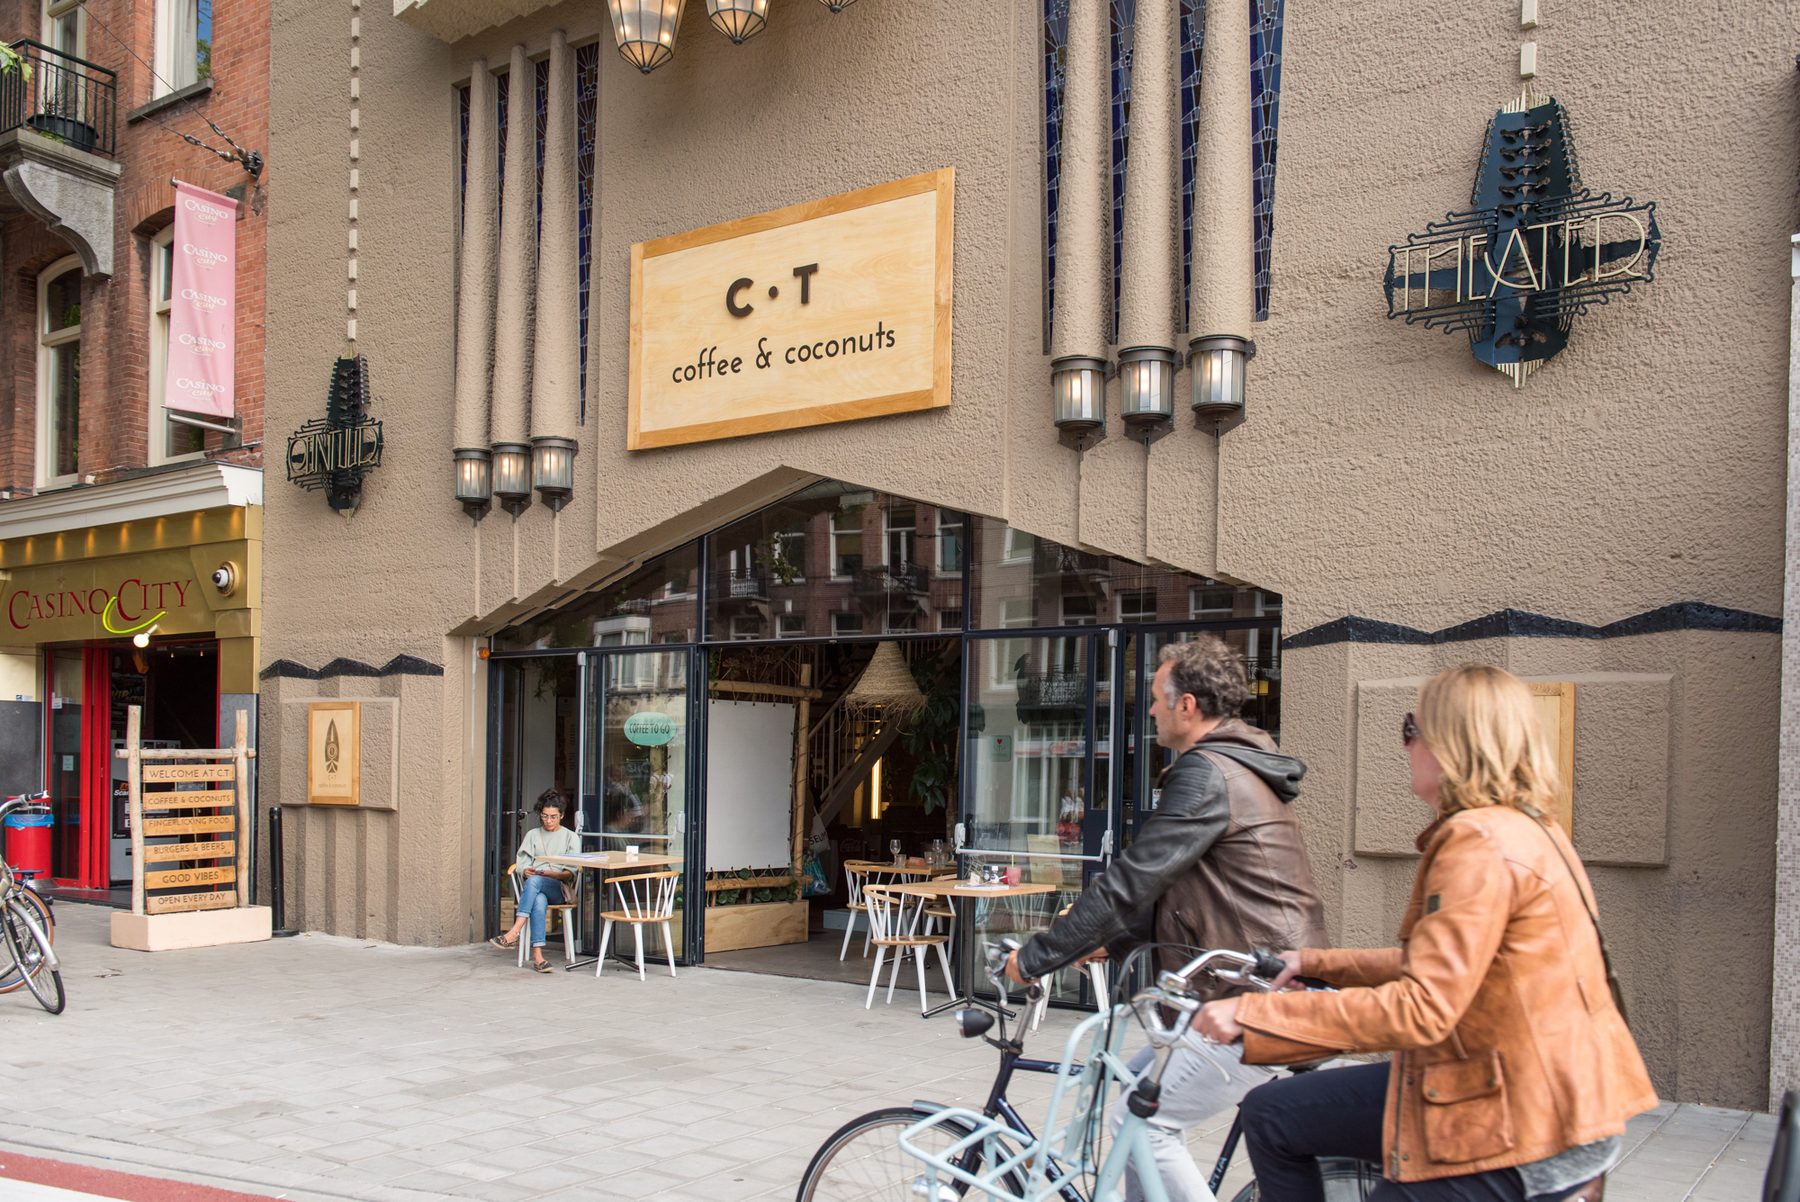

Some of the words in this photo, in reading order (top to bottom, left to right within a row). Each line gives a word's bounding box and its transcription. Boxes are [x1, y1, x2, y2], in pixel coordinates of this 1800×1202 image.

[185, 199, 229, 219] CASINO
[183, 243, 228, 263] CASINO
[181, 288, 228, 306] CASINO
[178, 333, 226, 350] CASINO
[671, 345, 743, 384] coffee
[755, 337, 773, 370] &
[784, 321, 896, 365] coconuts
[176, 378, 225, 393] CASINO
[8, 590, 110, 630] CASINO
[116, 578, 192, 622] CITY
[629, 723, 649, 734] COFFEE
[650, 723, 659, 734] TO
[660, 723, 670, 735] GO
[148, 769, 199, 779] WELCOME
[202, 769, 214, 778] AT
[148, 796, 178, 805] COFFEE
[188, 794, 231, 804] COCONUTS
[148, 817, 207, 828] FINGERLICKING
[208, 816, 230, 825] FOOD
[153, 844, 190, 855] BURGERS
[192, 843, 198, 852] &
[201, 842, 226, 851] BEERS
[162, 873, 191, 884] GOOD
[194, 870, 219, 881] VIBES
[157, 896, 181, 905] OPEN
[183, 894, 207, 903] EVERY
[209, 893, 226, 901] DAY
